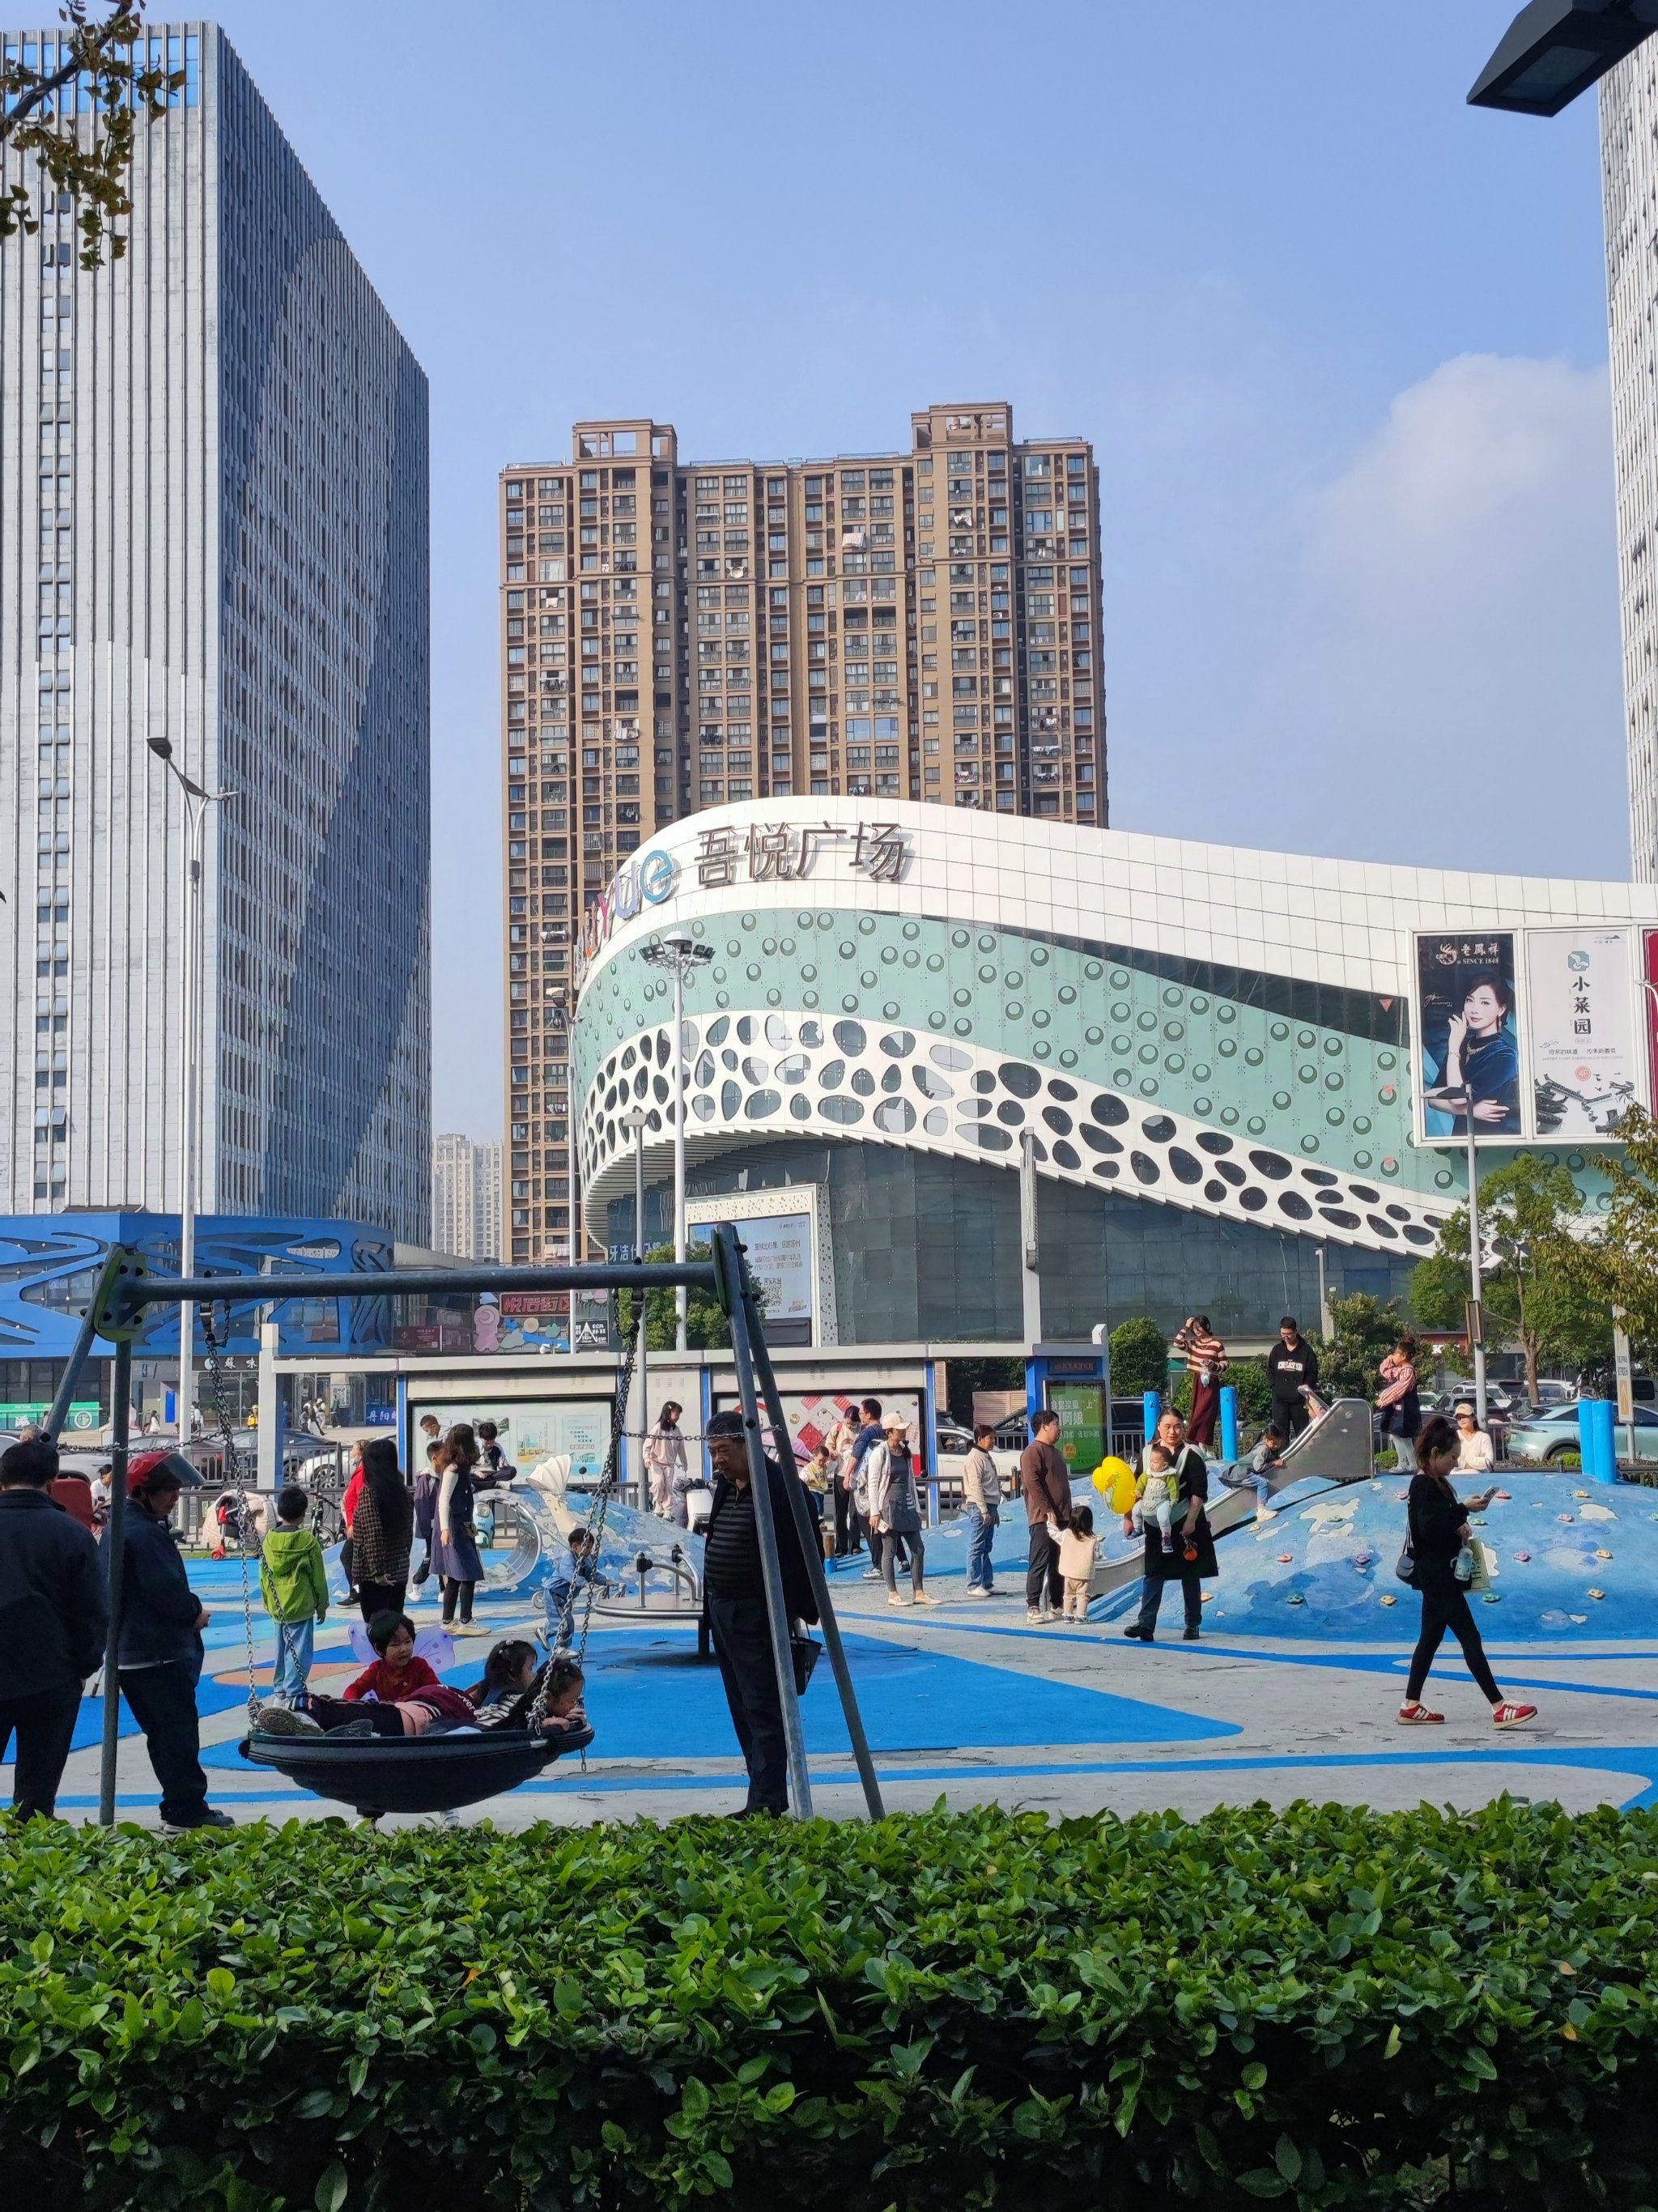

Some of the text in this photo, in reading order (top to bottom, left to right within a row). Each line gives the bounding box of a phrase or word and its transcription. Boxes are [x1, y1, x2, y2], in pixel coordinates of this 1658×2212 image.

[695, 820, 905, 887] 吾悦广场
[1572, 976, 1592, 1035] 小菜园
